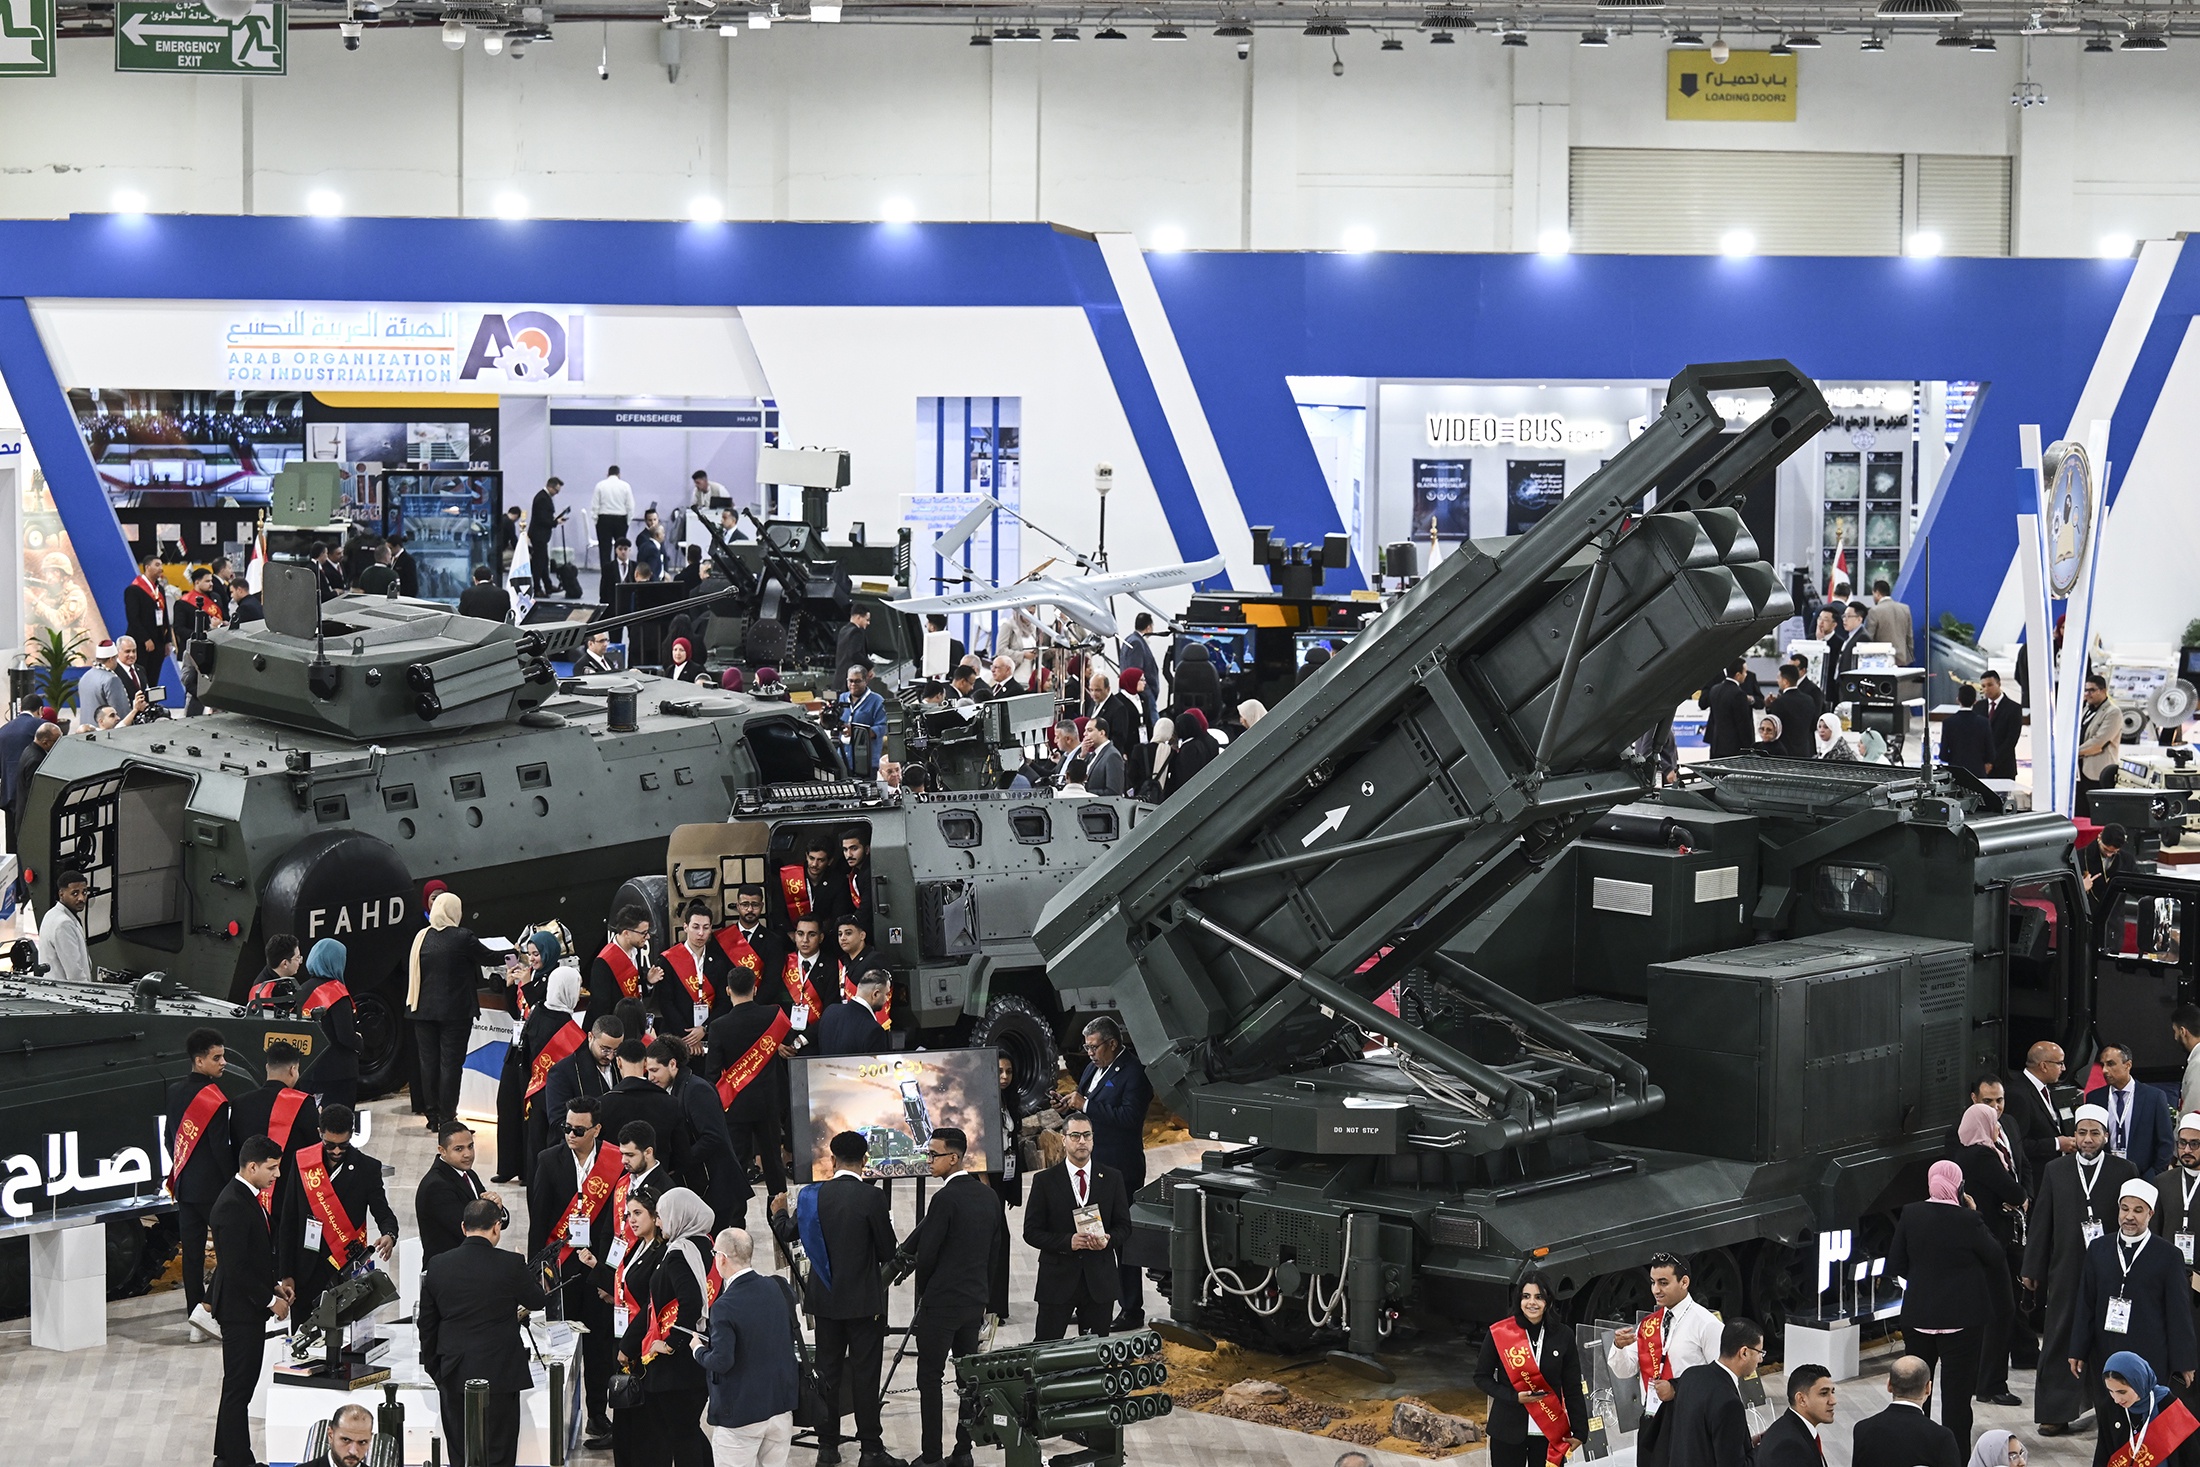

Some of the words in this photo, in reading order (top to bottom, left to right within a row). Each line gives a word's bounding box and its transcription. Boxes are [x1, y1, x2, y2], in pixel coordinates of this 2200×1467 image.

[151, 11, 186, 21] الطوارئ
[189, 11, 210, 20] حالة
[156, 41, 221, 54] EMERGENCY
[178, 55, 202, 67] EXIT
[1762, 73, 1787, 88] باب
[1705, 93, 1750, 102] LOADING
[1752, 94, 1786, 102] DOOR2
[226, 311, 304, 343] للتصنيع
[312, 311, 378, 342] العربية
[385, 311, 453, 338] الهيئة
[229, 352, 281, 365] ARAB
[293, 353, 452, 367] ORGANIZATION
[228, 368, 262, 381] FOR
[270, 368, 452, 382] INDUSTRIALIZATION
[615, 413, 683, 423] DEFENSEHERE
[1430, 418, 1497, 442] VIDEO
[1519, 418, 1563, 443] BUS
[950, 593, 992, 606] HAMZA
[309, 896, 405, 938] FAHD
[1931, 981, 1956, 991] BATTERIES
[859, 1063, 888, 1078] 300
[316, 1192, 332, 1217] الشروق
[329, 1216, 348, 1242] أكاديمية
